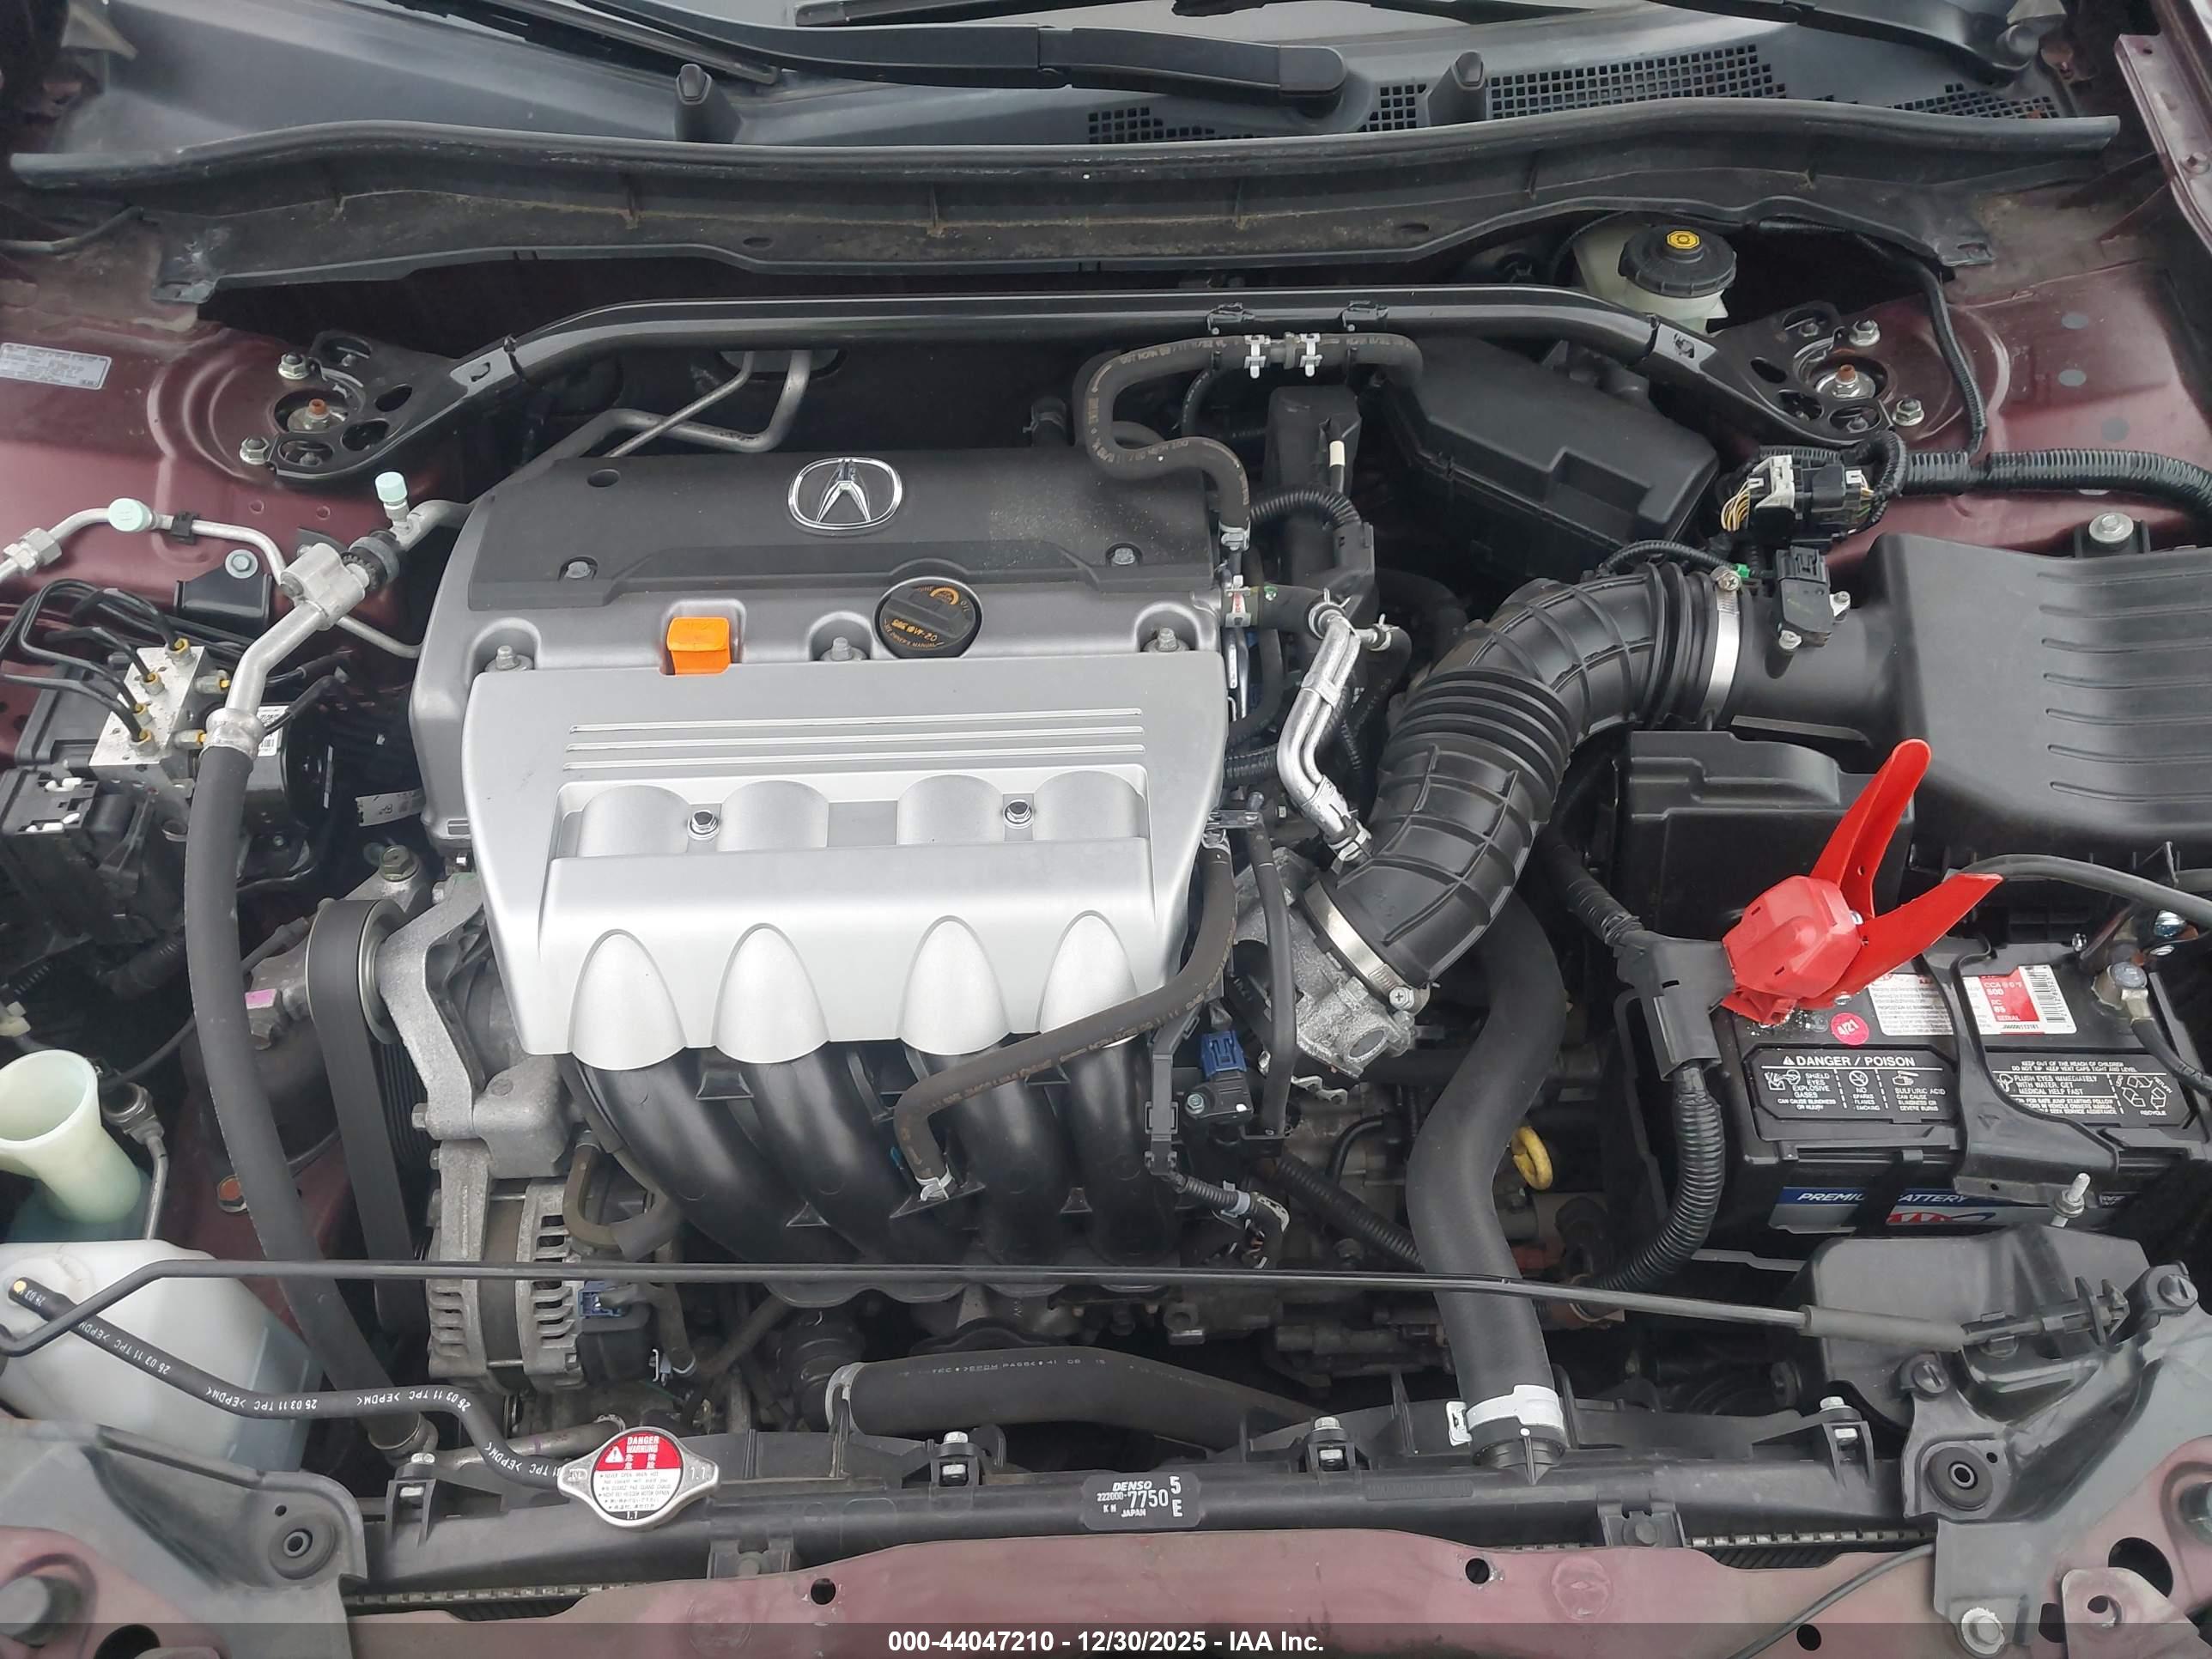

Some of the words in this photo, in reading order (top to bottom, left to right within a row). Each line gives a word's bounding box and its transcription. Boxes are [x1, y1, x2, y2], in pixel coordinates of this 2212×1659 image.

[1796, 1056, 1851, 1066] DANGER
[1854, 1056, 1860, 1066] /
[1864, 1056, 1916, 1066] POISON
[1796, 1193, 1867, 1201] PREMIU
[1898, 1194, 1970, 1202] ATTERY
[113, 1340, 132, 1355] TPC
[132, 1350, 144, 1361] 11
[144, 1356, 158, 1368] 03
[409, 1389, 429, 1400] TPC
[433, 1389, 443, 1400] 11
[446, 1391, 459, 1403] 03
[254, 1401, 274, 1412] TPC
[278, 1401, 288, 1411] 11
[290, 1400, 302, 1410] 03
[627, 1436, 659, 1444] DANGER
[529, 1463, 549, 1477] TPC
[1112, 1480, 1152, 1492] DENSO
[1169, 1475, 1182, 1494] 5
[1097, 1489, 1169, 1509] 222000-7750
[1121, 1509, 1146, 1518] JAPAN
[1171, 1499, 1183, 1517] E
[627, 1511, 638, 1520] 1.1
